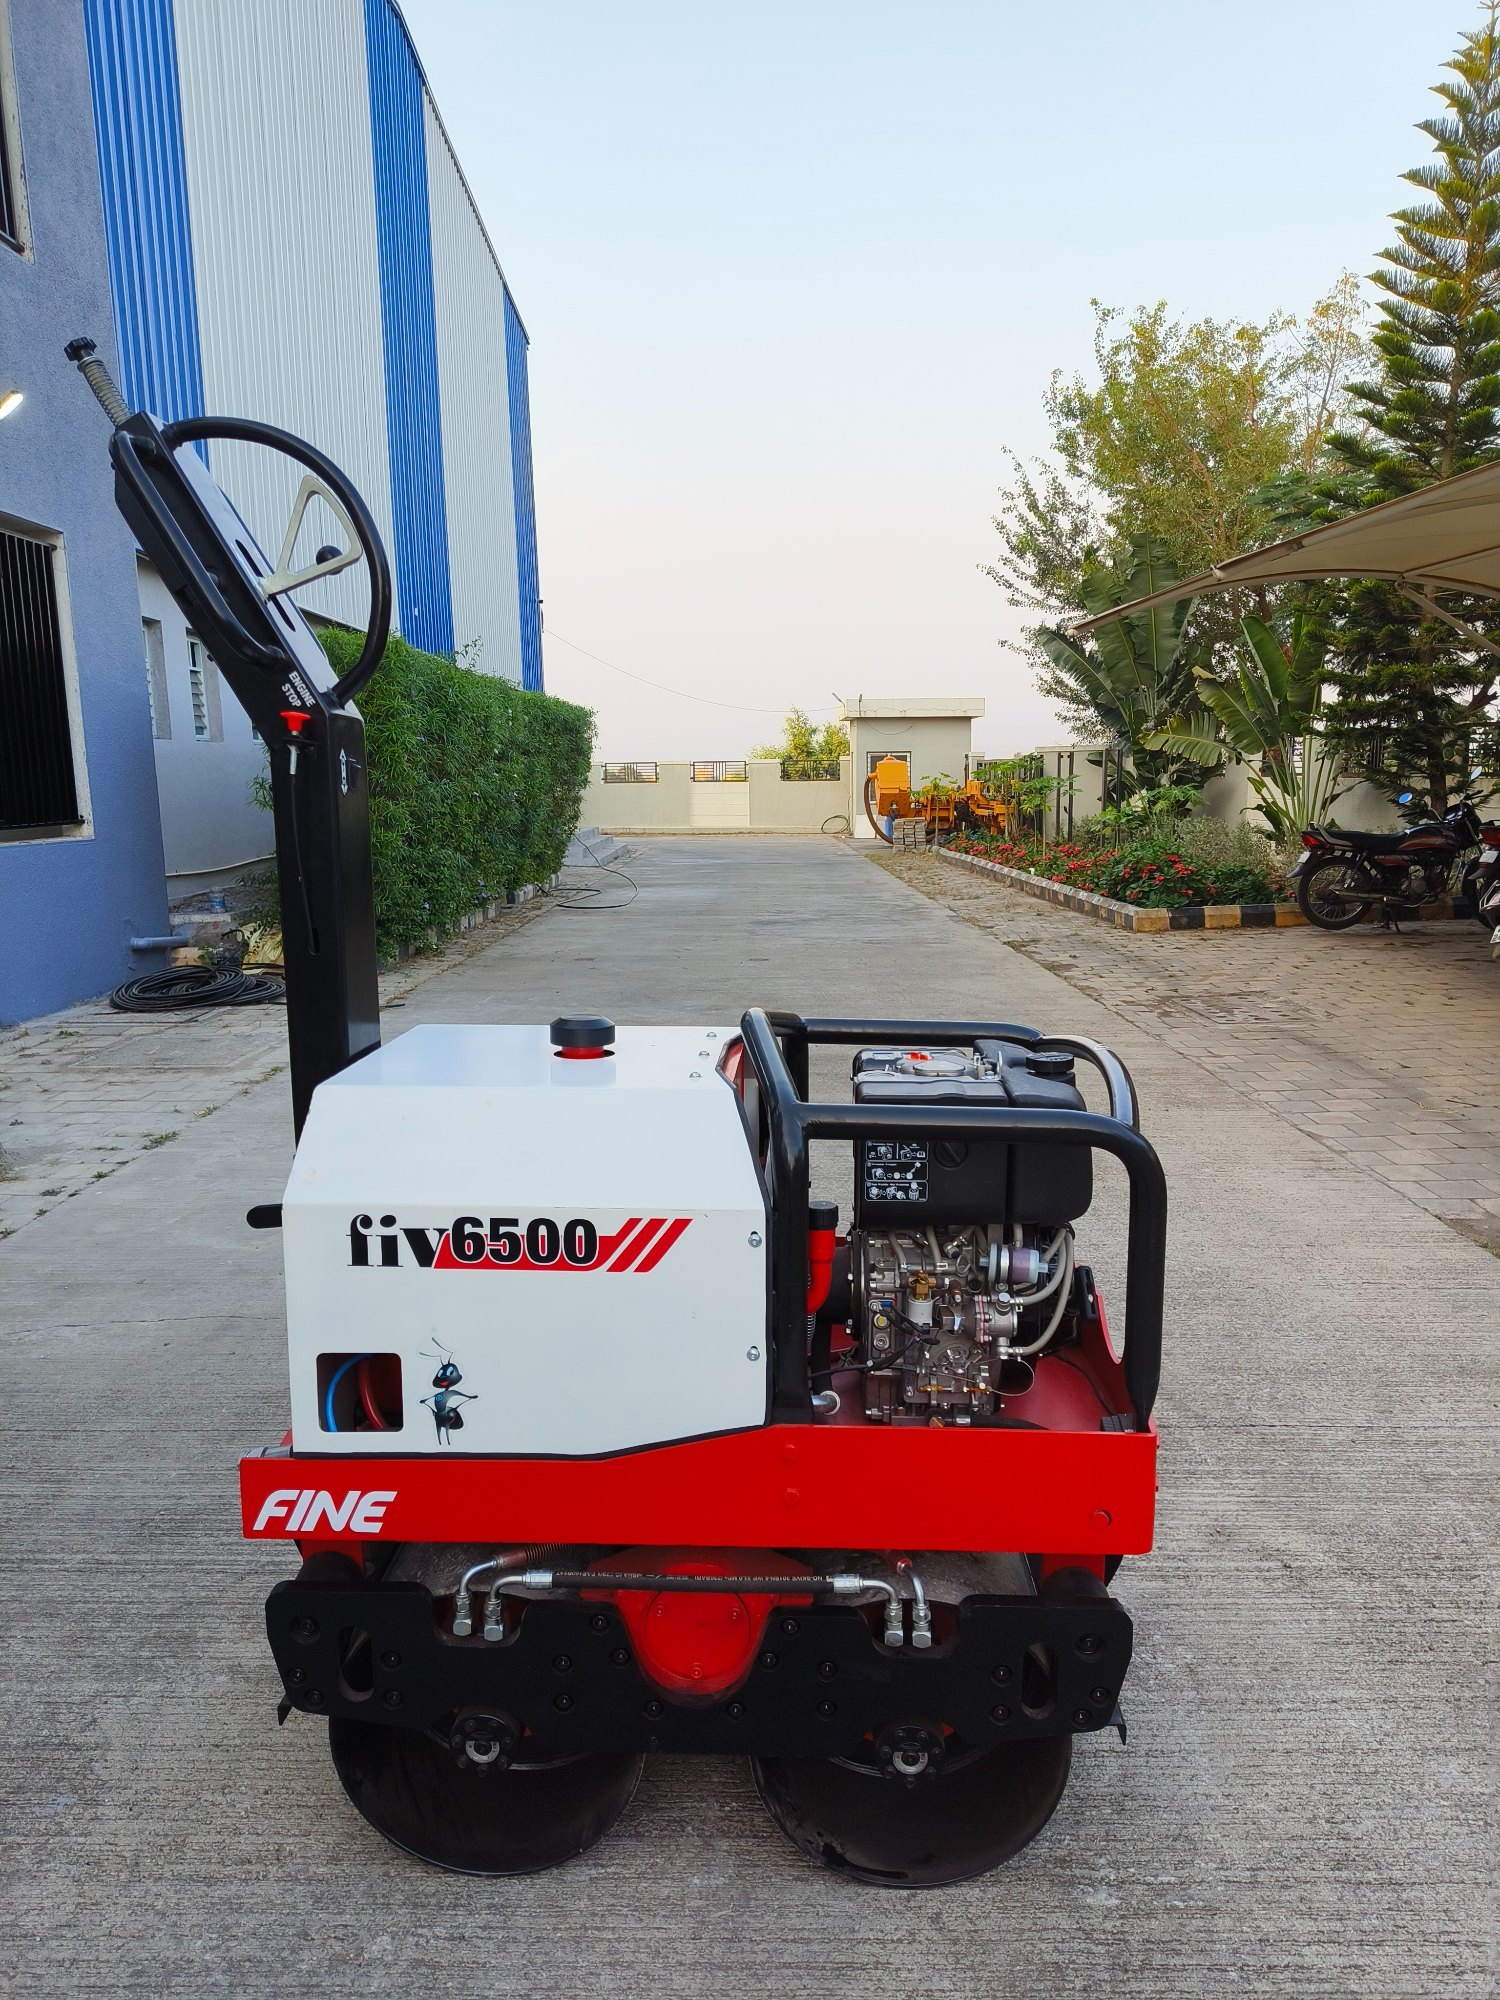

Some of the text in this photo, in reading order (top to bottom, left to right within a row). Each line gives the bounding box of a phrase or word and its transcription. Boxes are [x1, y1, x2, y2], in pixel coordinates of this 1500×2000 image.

[281, 683, 301, 707] STOP
[289, 671, 316, 708] ENGINE
[252, 1489, 398, 1533] FINE
